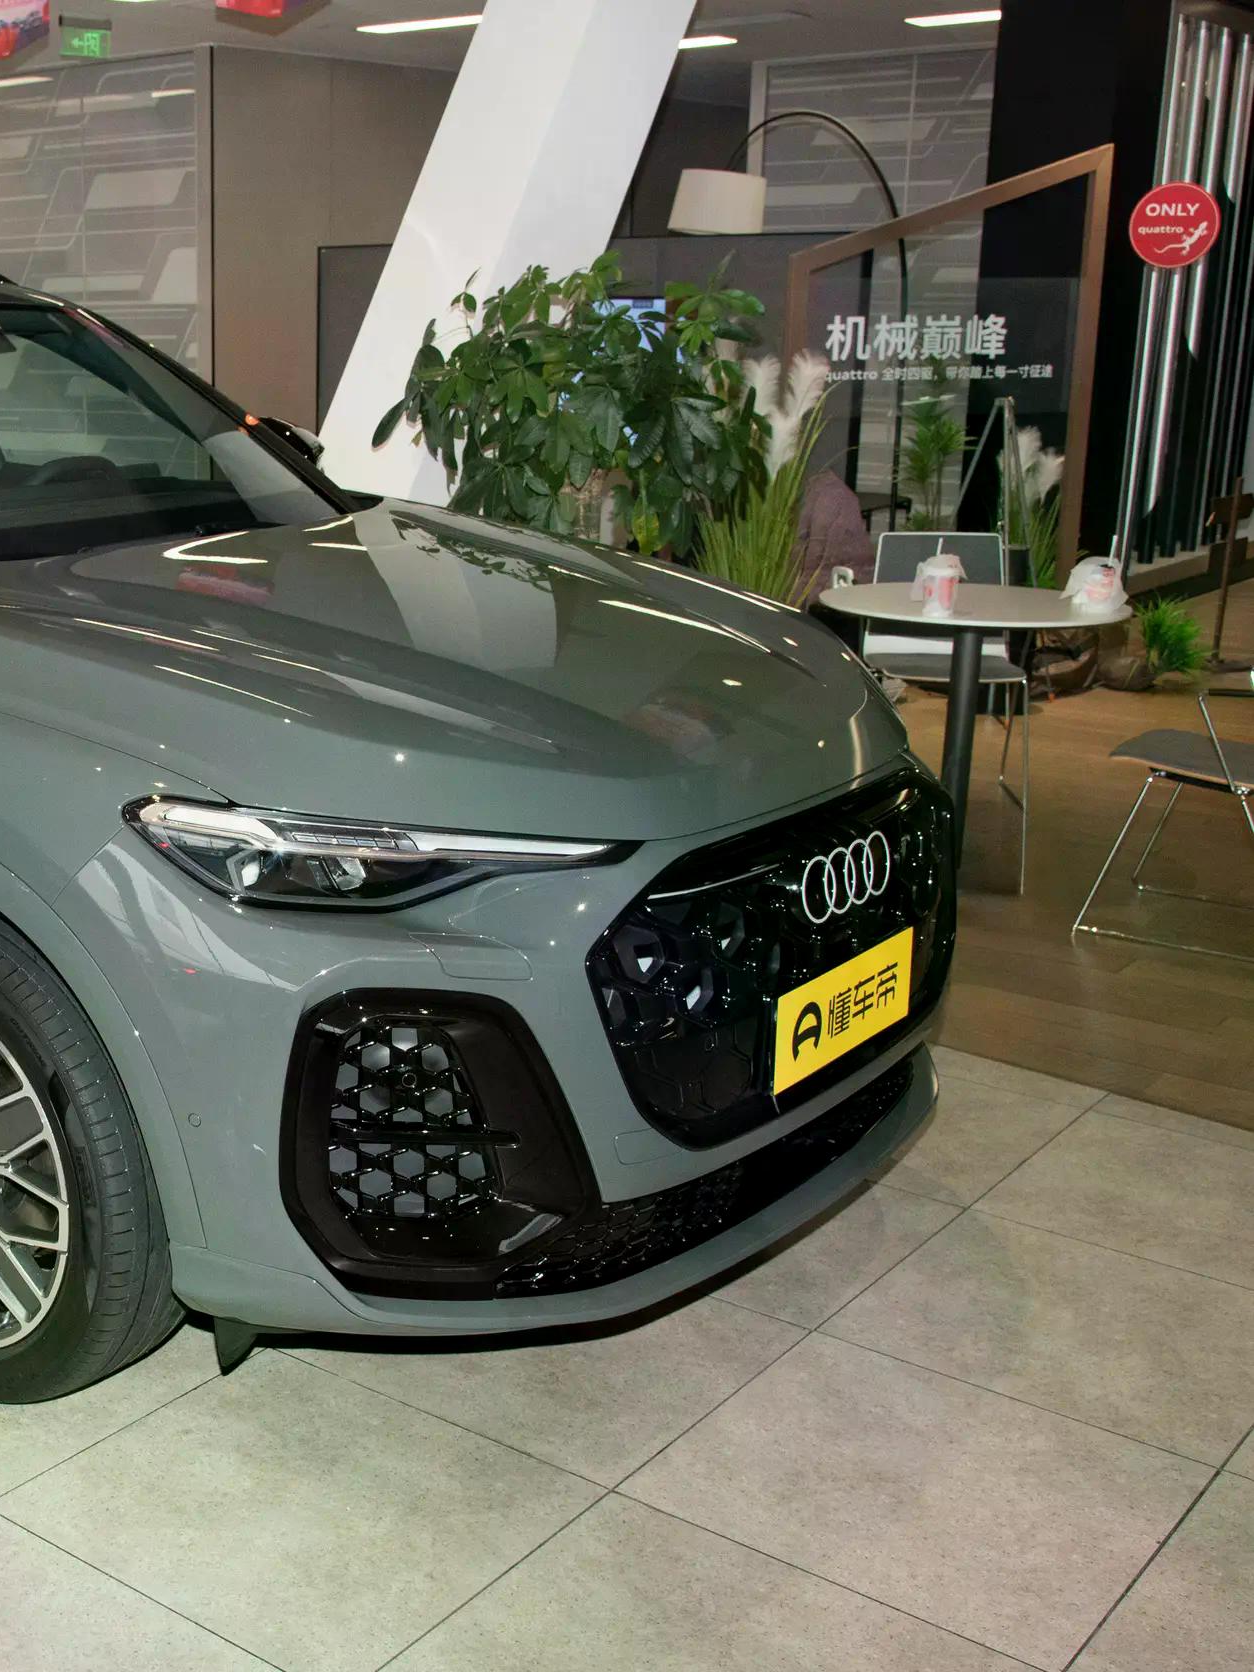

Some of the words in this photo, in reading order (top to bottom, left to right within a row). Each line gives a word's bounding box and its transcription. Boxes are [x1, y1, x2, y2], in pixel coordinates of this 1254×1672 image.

[1145, 202, 1200, 217] ONLY
[1137, 225, 1184, 235] quattro
[825, 313, 1008, 361] 机械巅峰
[824, 367, 879, 383] quattro
[827, 961, 899, 1039] 懂车帝
